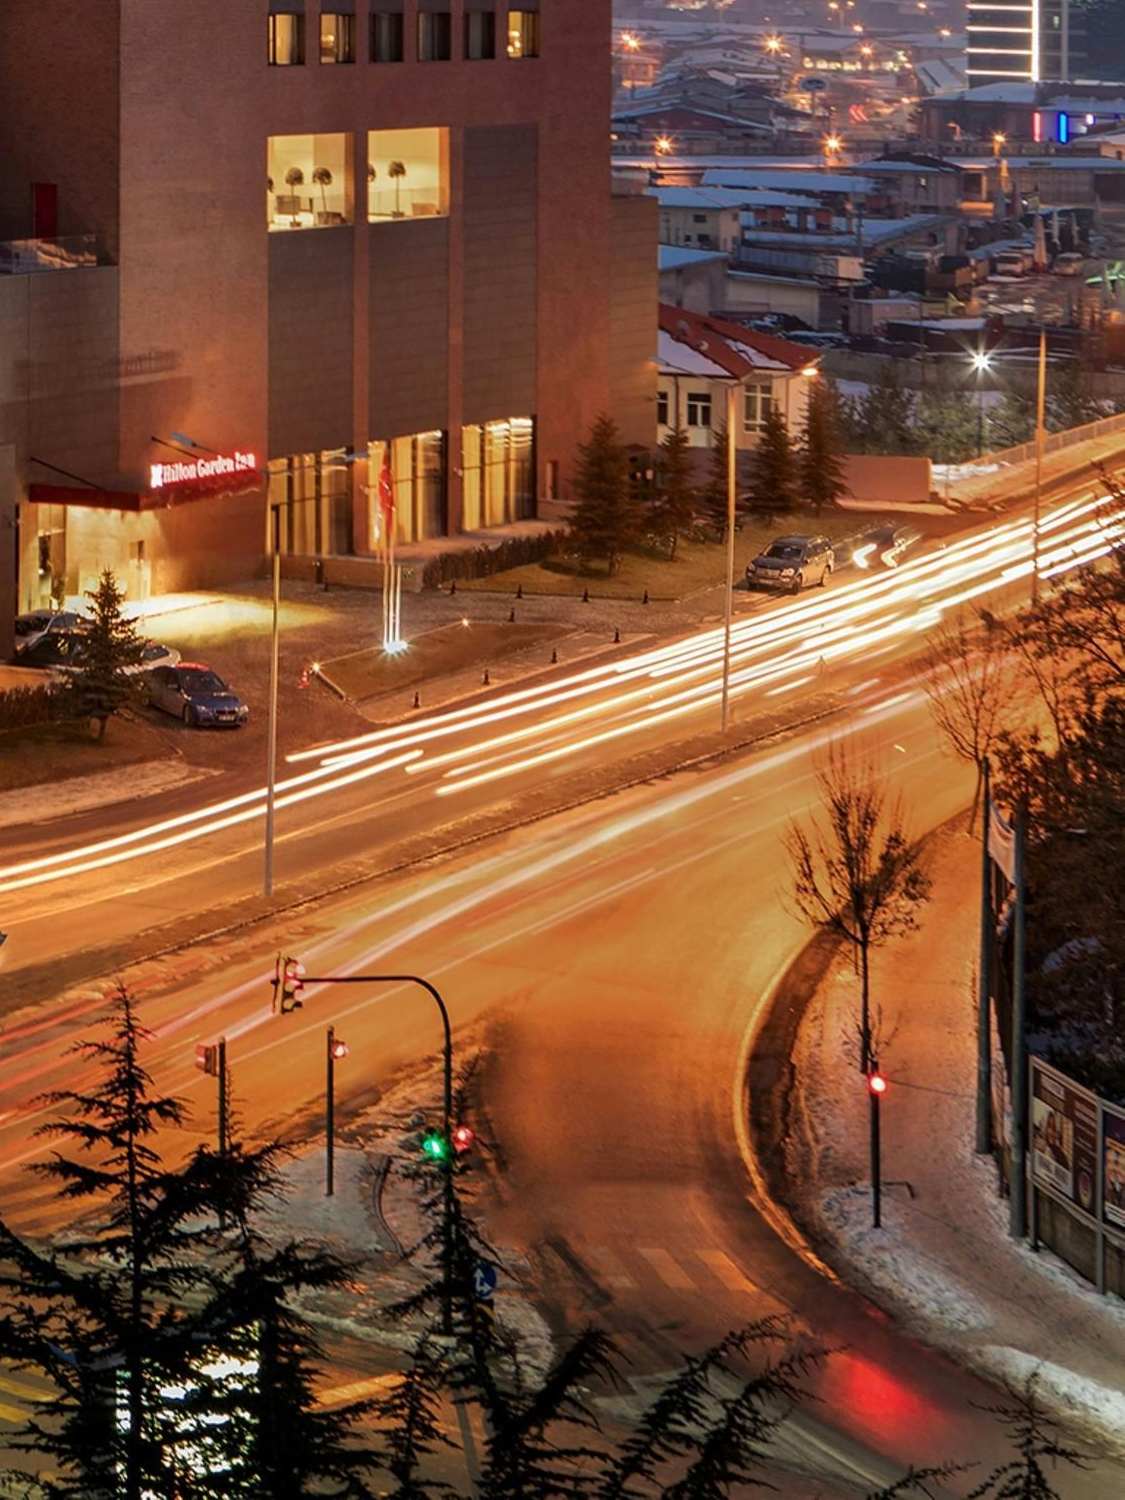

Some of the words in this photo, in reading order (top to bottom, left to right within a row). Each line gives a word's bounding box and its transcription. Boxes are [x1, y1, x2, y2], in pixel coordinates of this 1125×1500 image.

[163, 462, 197, 484] Hilton
[197, 455, 235, 478] Garden
[235, 451, 255, 471] Inn
